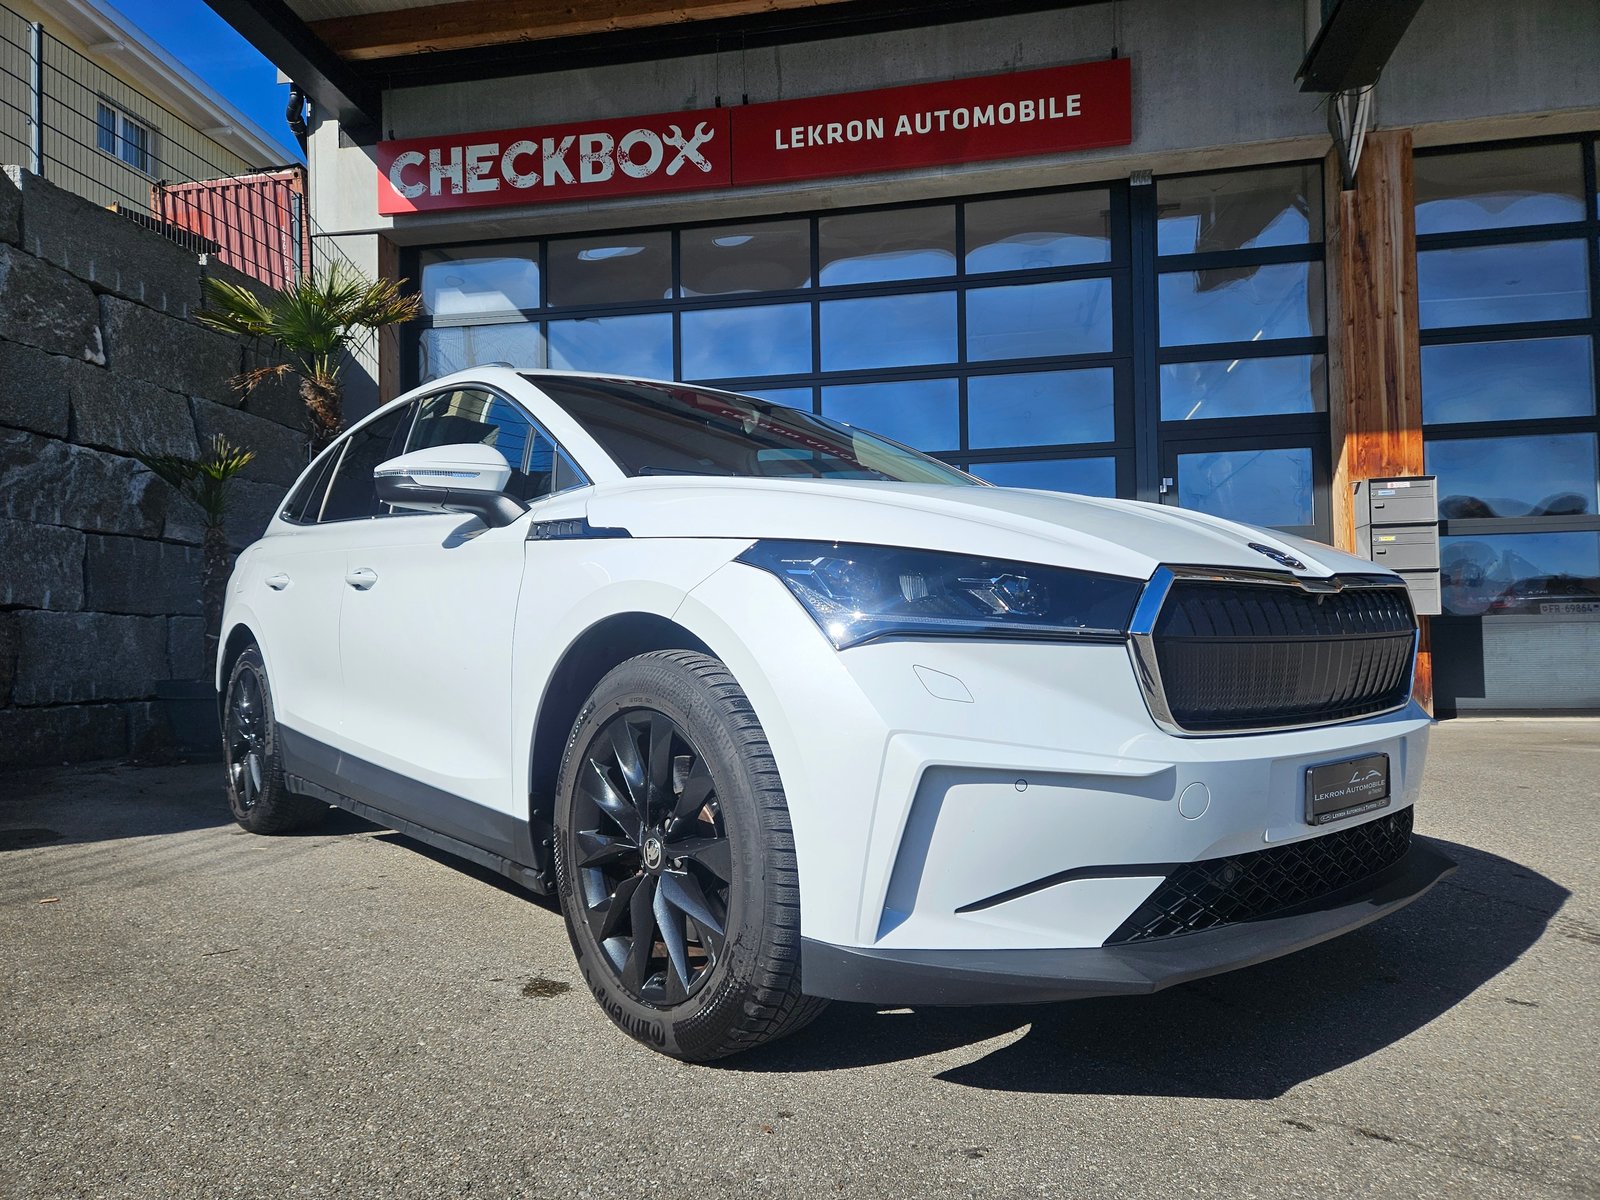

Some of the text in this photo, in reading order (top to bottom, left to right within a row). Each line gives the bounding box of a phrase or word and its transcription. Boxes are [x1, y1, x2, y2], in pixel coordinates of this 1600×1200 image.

[775, 94, 1082, 150] LEKRON AUTOMOBILE
[1314, 789, 1345, 801] LEKRON
[1346, 779, 1386, 795] AUTOMOBILE
